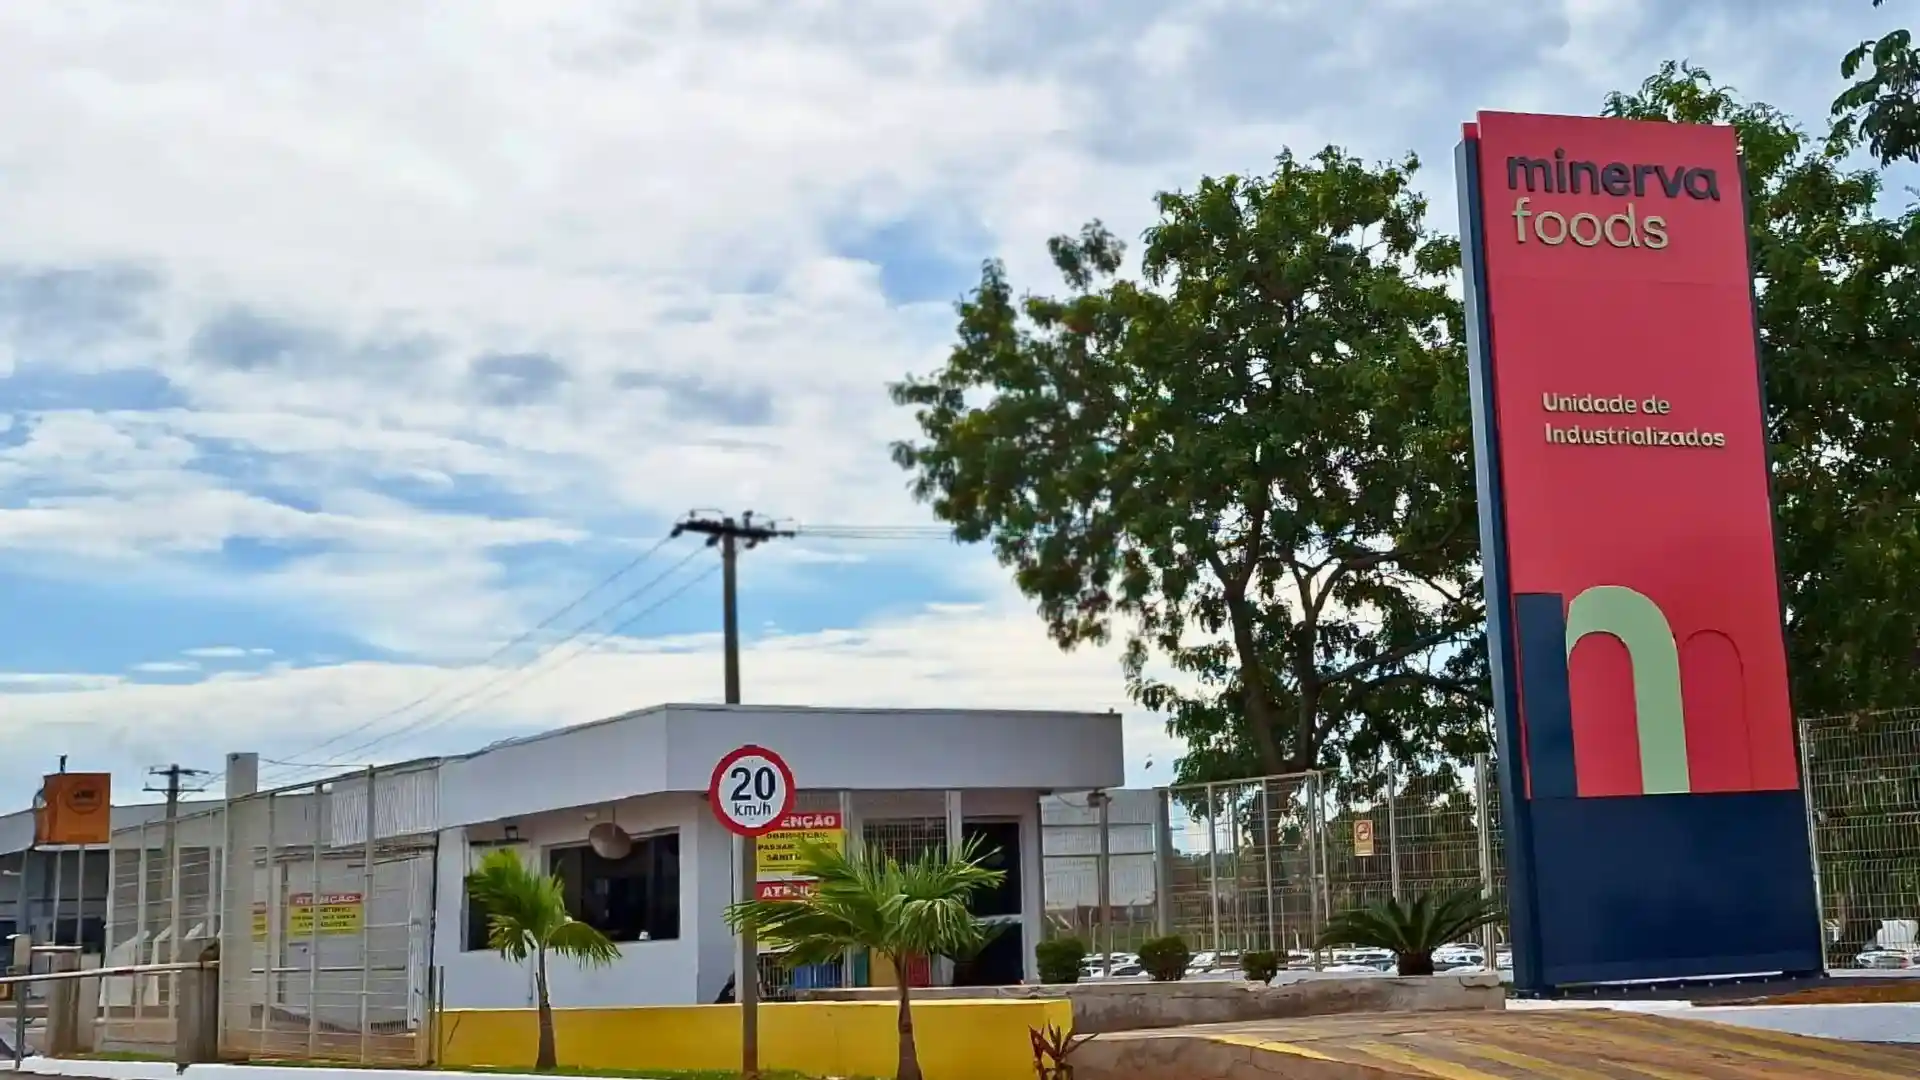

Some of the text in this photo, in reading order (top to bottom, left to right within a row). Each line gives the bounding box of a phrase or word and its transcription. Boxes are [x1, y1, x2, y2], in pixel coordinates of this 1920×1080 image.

[1506, 147, 1721, 201] minerva
[1512, 197, 1669, 249] foods
[1542, 392, 1670, 415] Unidade de
[1544, 422, 1726, 448] Industrializados
[730, 766, 776, 801] 20
[734, 801, 772, 817] km/h
[781, 814, 836, 829] ENÇÃO
